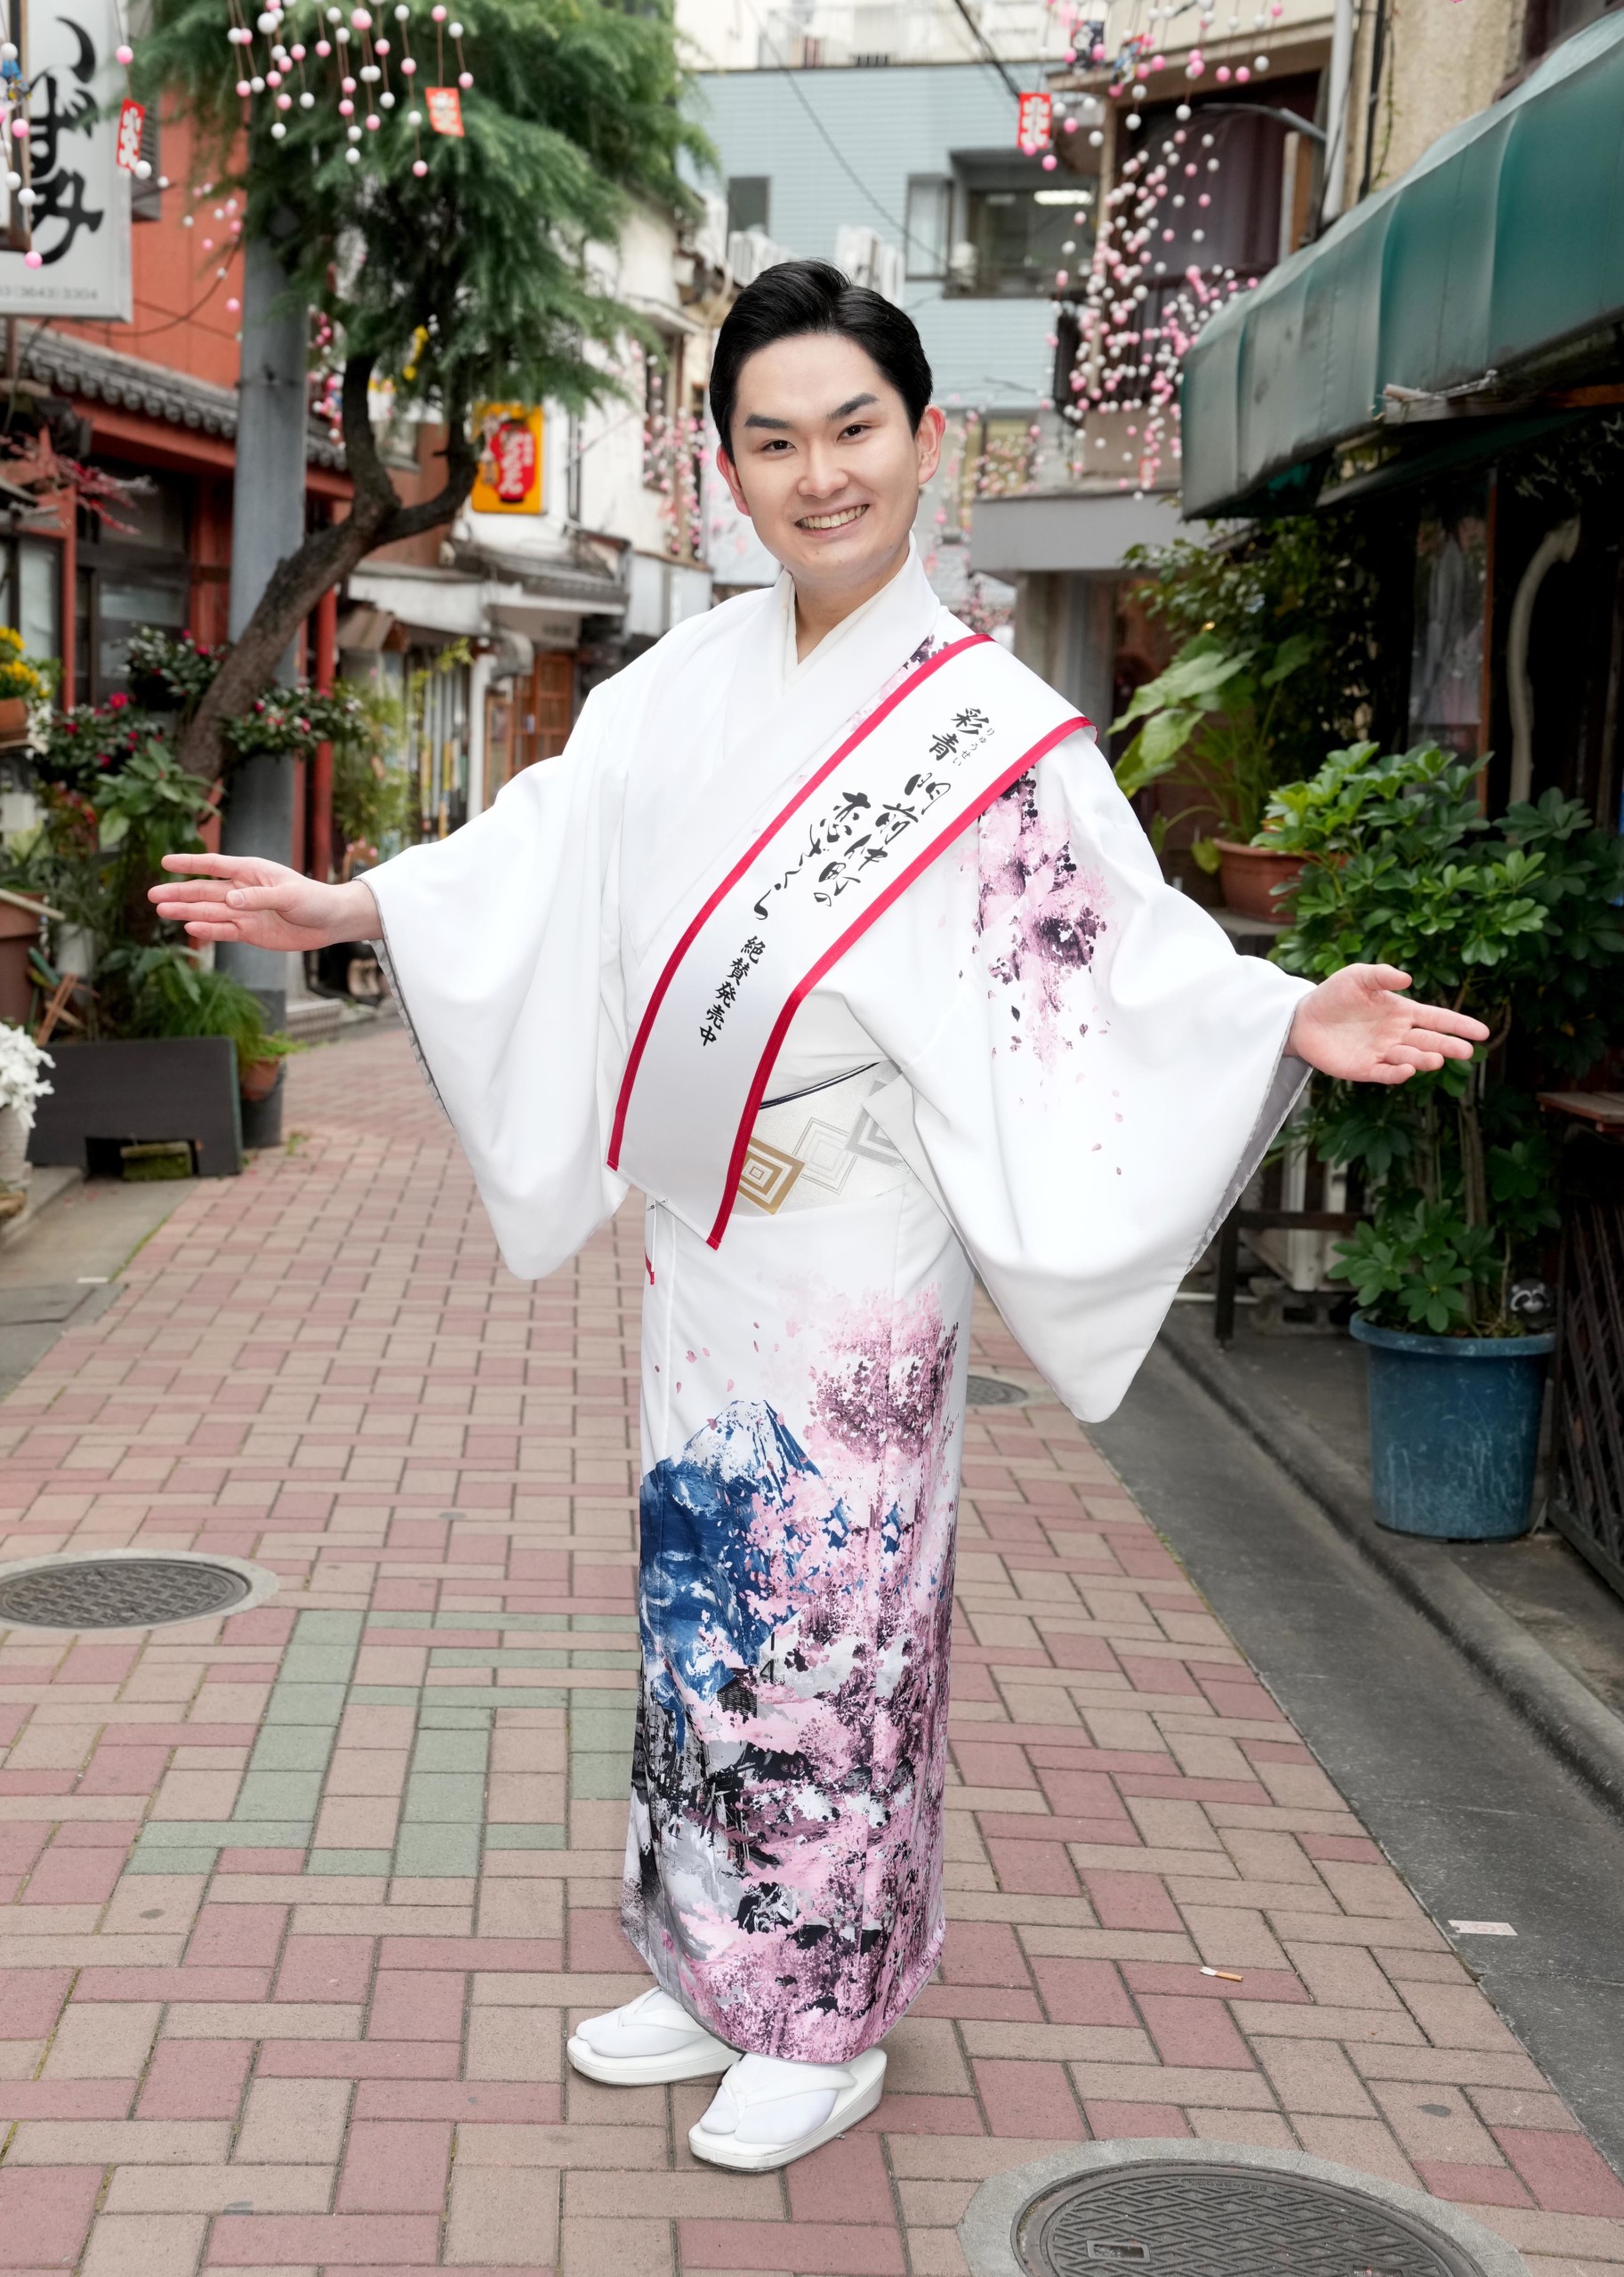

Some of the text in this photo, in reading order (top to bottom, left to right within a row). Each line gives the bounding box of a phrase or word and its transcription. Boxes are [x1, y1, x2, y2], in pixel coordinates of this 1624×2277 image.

[929, 708, 989, 760] 彩青
[953, 728, 995, 766] りゅうせい
[699, 935, 766, 1047] 絶賛発売中
